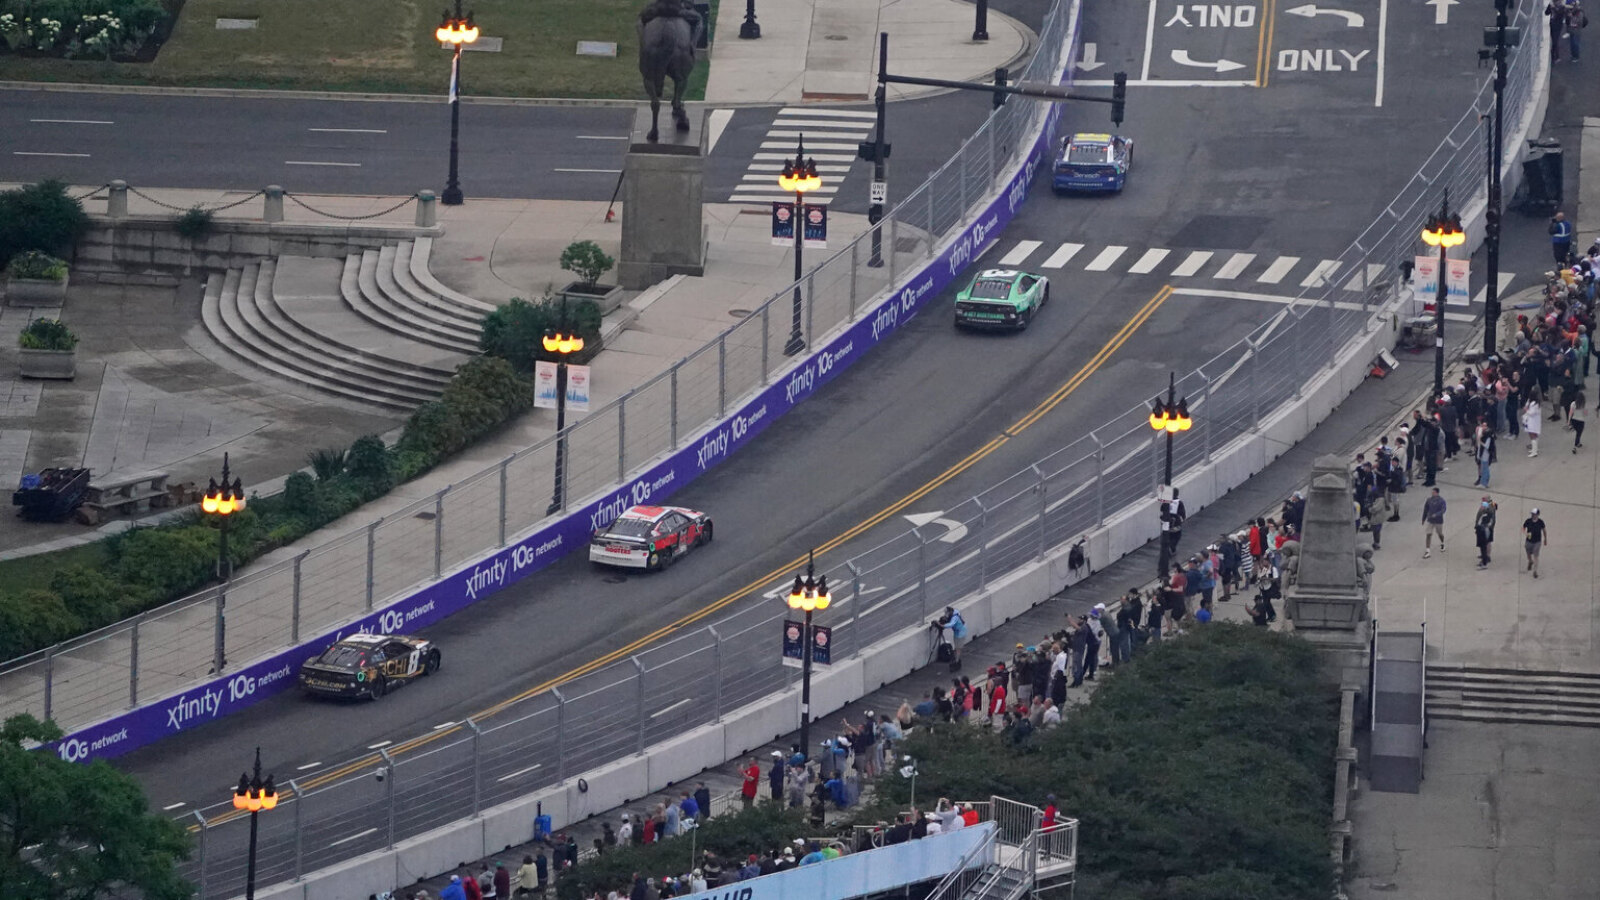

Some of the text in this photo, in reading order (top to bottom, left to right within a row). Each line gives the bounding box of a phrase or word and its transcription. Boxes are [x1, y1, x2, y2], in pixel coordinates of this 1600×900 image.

[1164, 5, 1256, 27] ONLY
[1277, 49, 1371, 72] ONLY
[872, 301, 899, 341] xfinity
[901, 287, 916, 314] 10G
[786, 364, 815, 403] xfinity
[818, 352, 833, 377] 10G
[697, 404, 767, 470] xfinity 10G network
[590, 469, 675, 531] xfinity 10G network
[465, 534, 562, 599] xfinity 10G network
[379, 600, 435, 634] 10G network
[407, 649, 420, 675] 8
[167, 664, 291, 729] xfinity 10G network
[58, 727, 128, 763] 10G network
